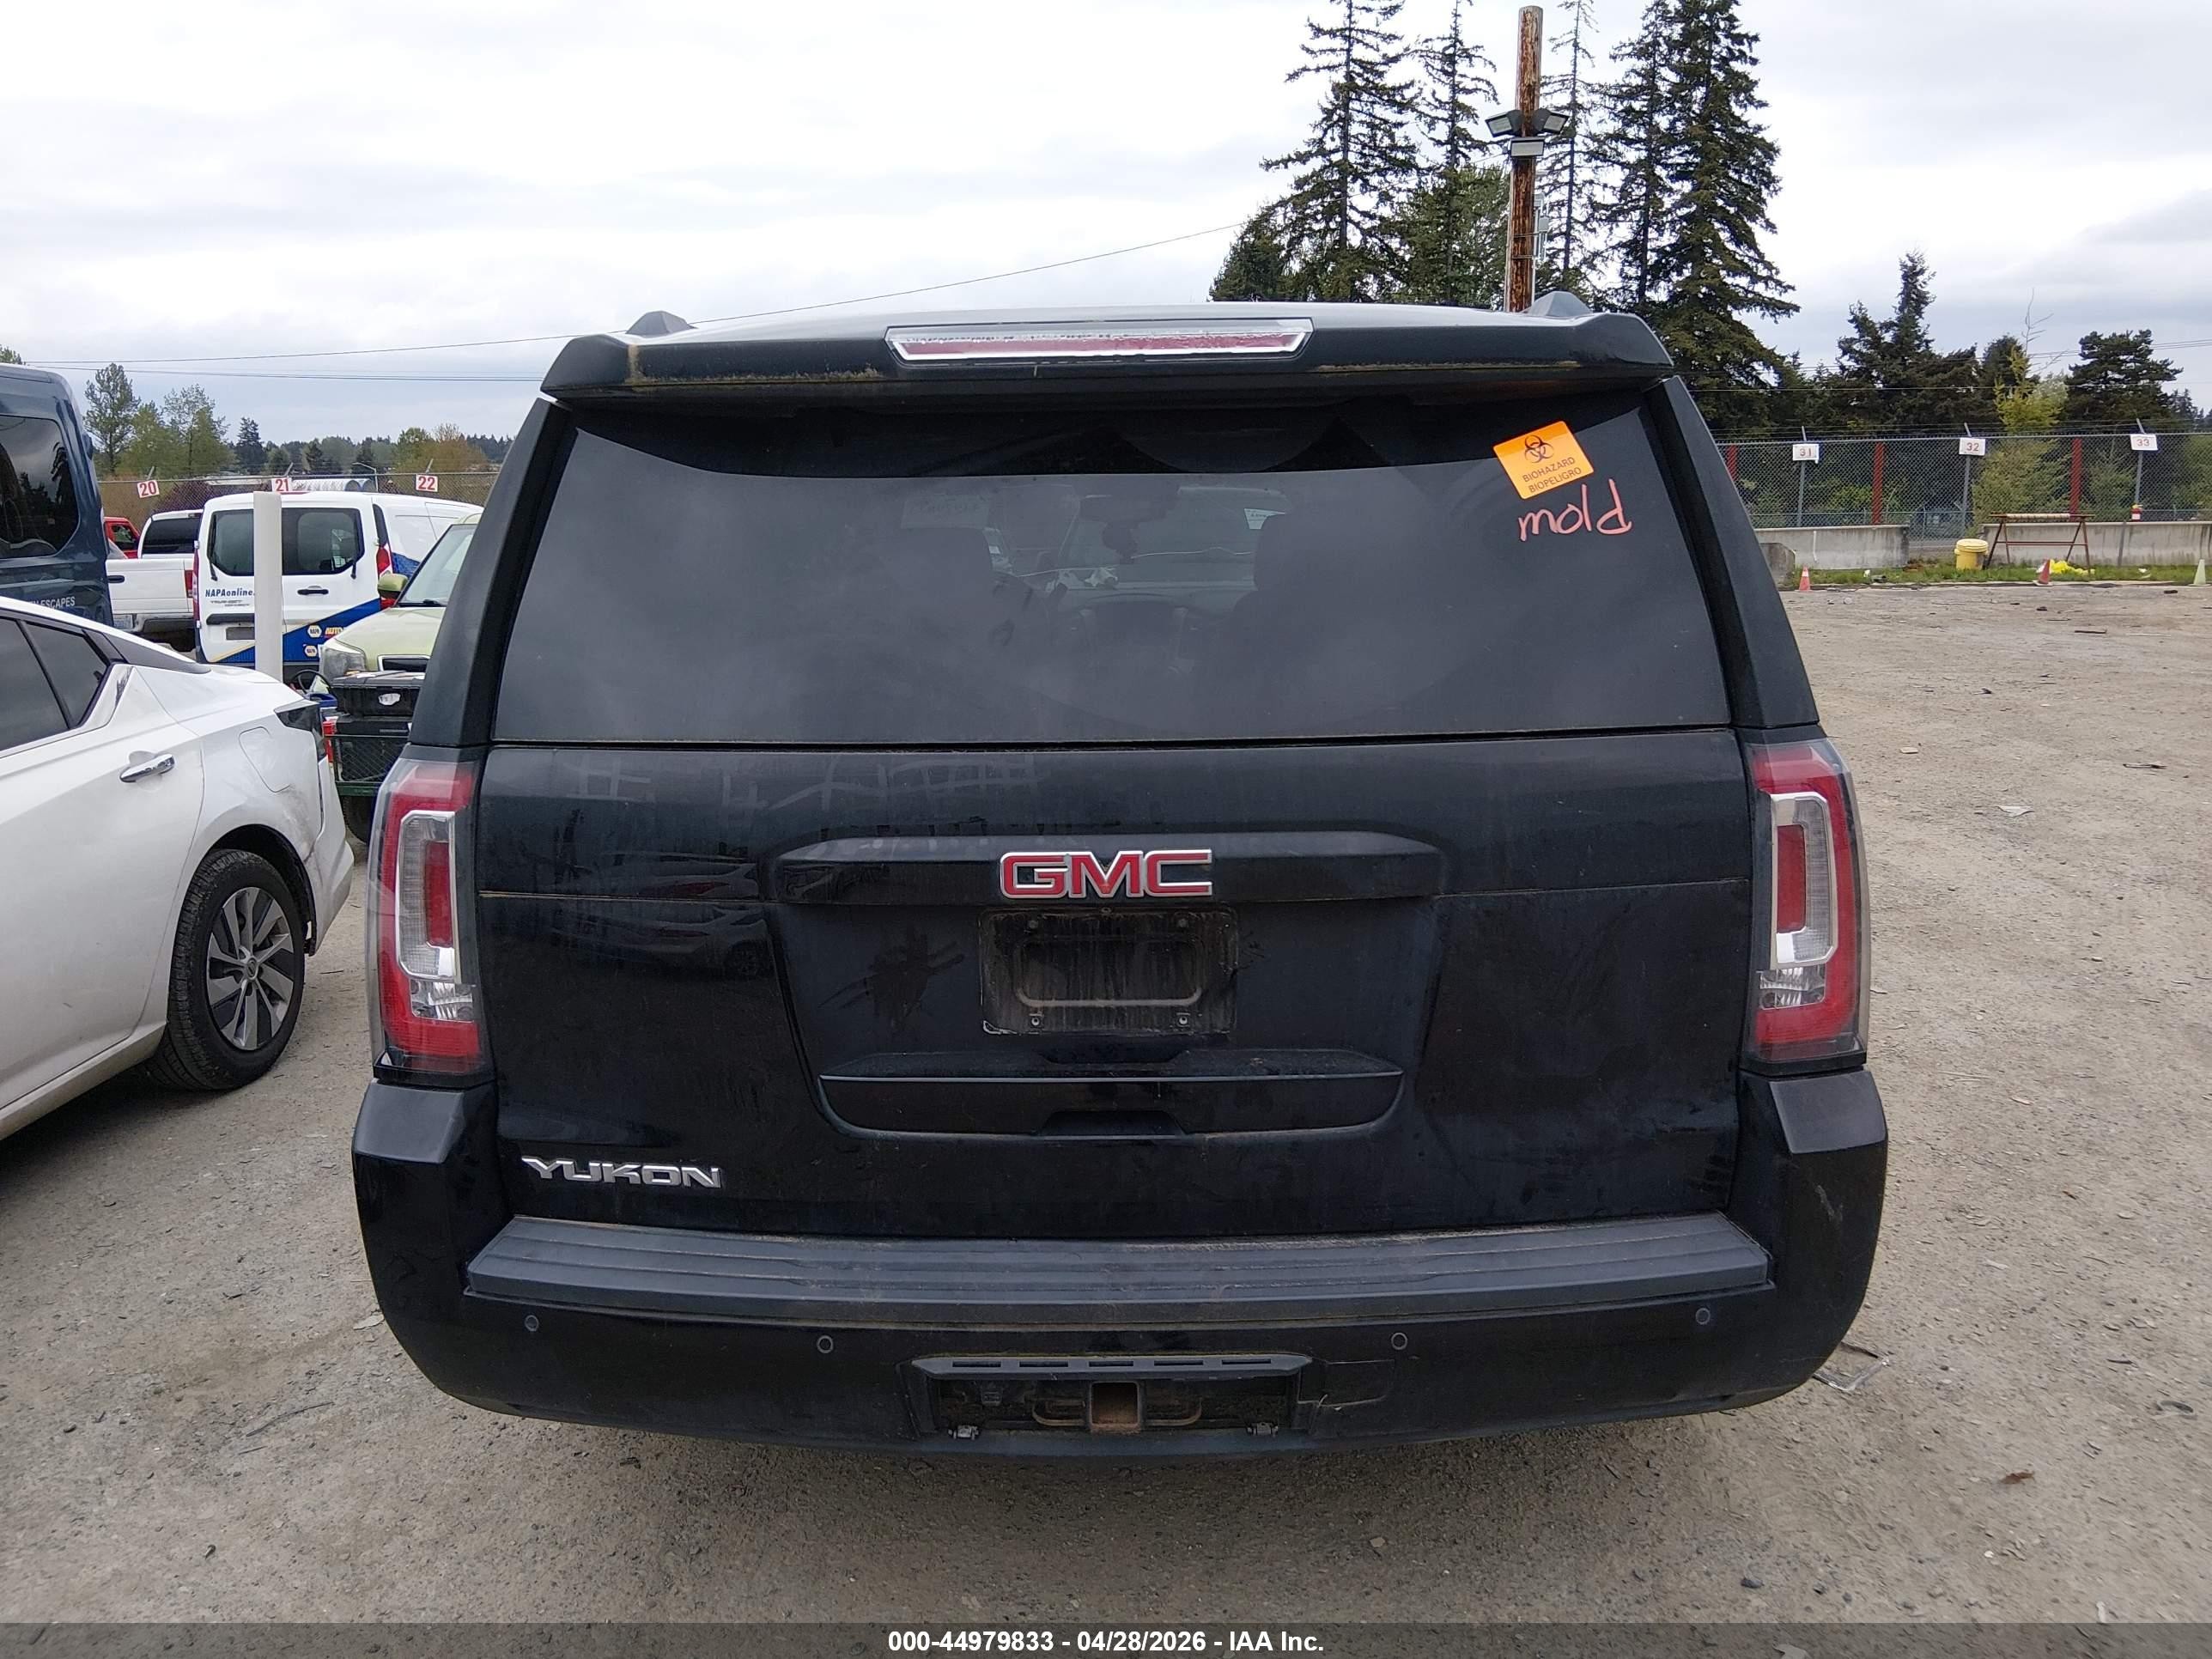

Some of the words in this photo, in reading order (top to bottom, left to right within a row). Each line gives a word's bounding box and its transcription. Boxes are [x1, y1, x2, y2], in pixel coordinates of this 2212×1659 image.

[1799, 447, 1812, 457] 31
[1966, 442, 1979, 452] 32
[1522, 457, 1575, 483] BIOHAZARD
[275, 478, 289, 492] 21
[418, 476, 435, 490] 22
[1528, 467, 1582, 493] BIOPELIGRO
[139, 481, 156, 496] 20
[1518, 478, 1632, 542] mold
[40, 596, 76, 610] ESCAPES
[1000, 848, 1213, 899] GMC
[521, 1157, 721, 1188] YUKON
